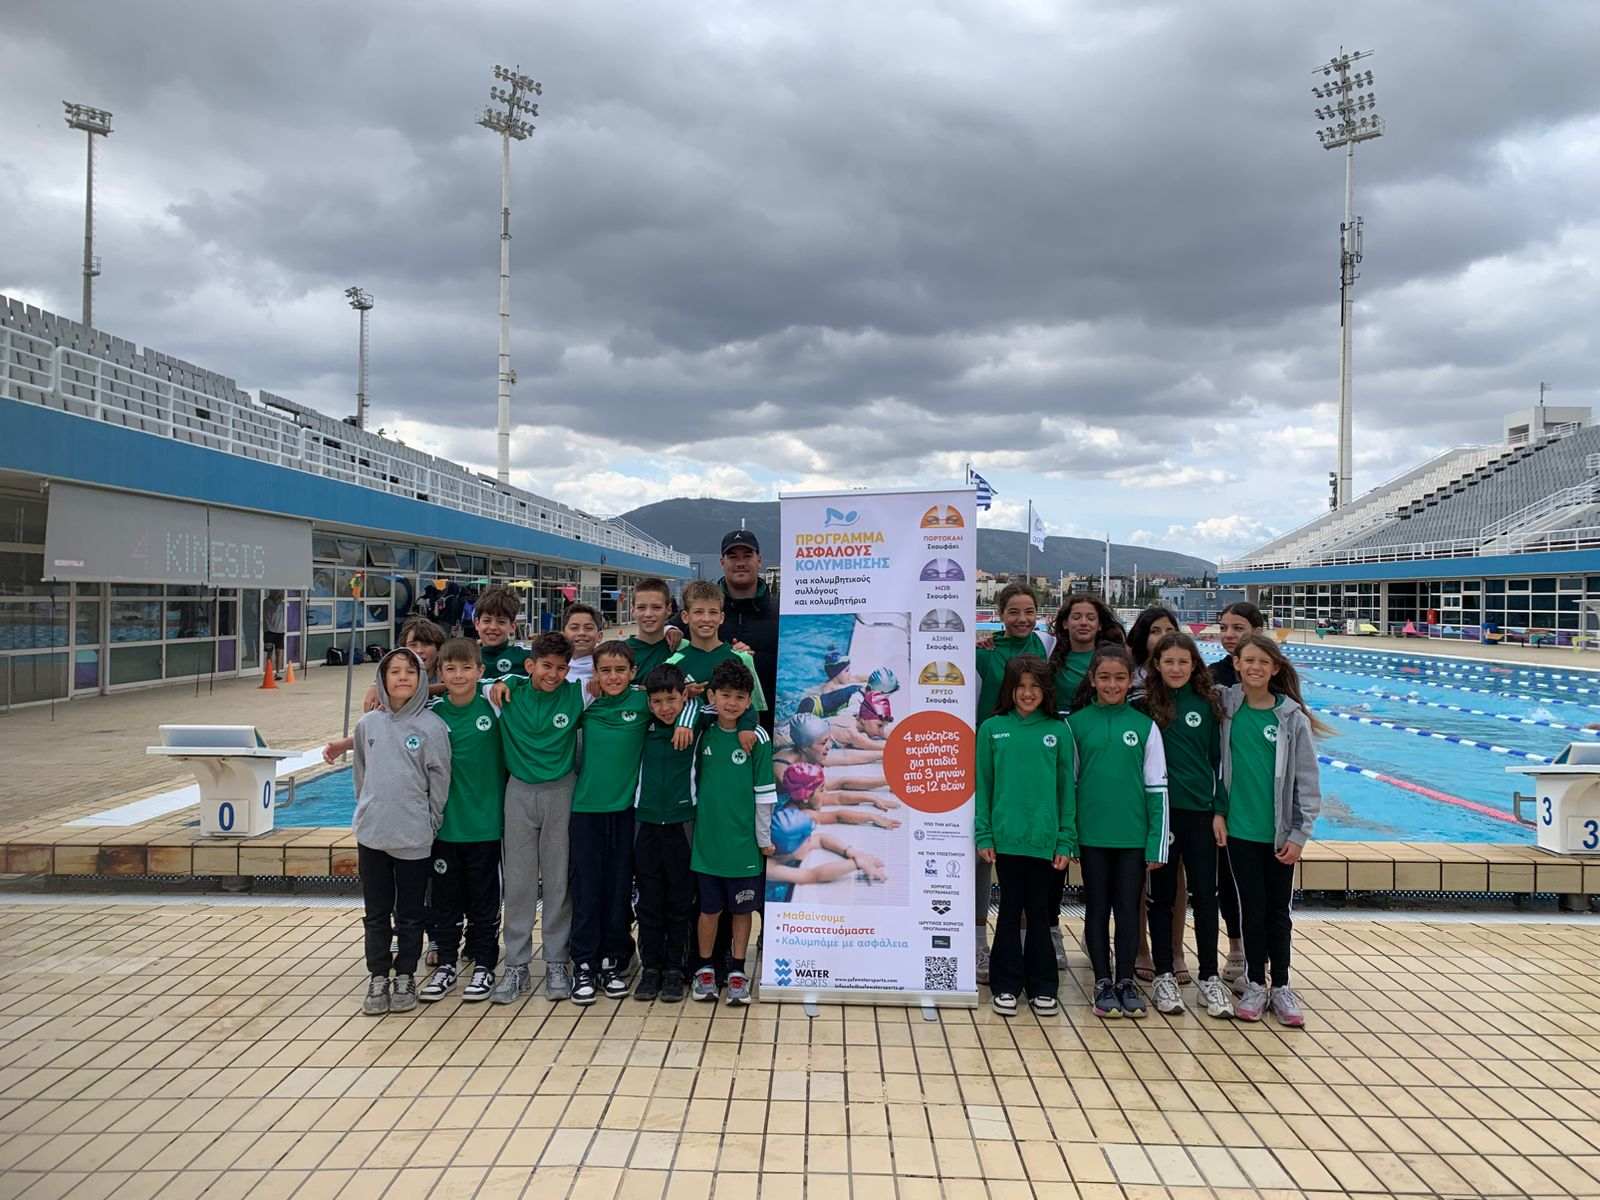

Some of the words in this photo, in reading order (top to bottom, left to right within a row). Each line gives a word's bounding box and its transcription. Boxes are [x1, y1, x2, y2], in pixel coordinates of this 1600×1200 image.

[795, 531, 885, 545] ΠΡΟΓΡΑΜΜΑ
[166, 530, 265, 578] KINESIS
[795, 545, 872, 558] ΑΣΦΑΛΟΥΣ
[795, 557, 890, 571] ΚΟΛΥΜΒΗΣΗΣ
[810, 574, 871, 585] κολυμβητικούς
[794, 587, 839, 595] συλλόγους
[809, 596, 867, 606] κολυμβητήρια
[926, 643, 959, 651] Σκουφάκι
[903, 731, 913, 742] 4
[914, 730, 960, 743] ενότητες
[905, 743, 959, 757] εκμάθησης
[909, 759, 924, 770] για
[926, 755, 957, 766] παιδιά
[903, 769, 923, 781] από
[924, 768, 934, 780] 3
[935, 767, 966, 782] μηνών
[905, 782, 926, 794] έως
[926, 781, 939, 792] 12
[940, 779, 966, 792] ετών
[263, 780, 271, 808] 0
[218, 802, 234, 831] 0
[1542, 796, 1552, 826] 3
[1582, 820, 1599, 849] 3
[783, 911, 845, 923] Μαθαίνουμε
[782, 923, 876, 937] Προστατευόμαστε
[782, 936, 839, 948] Κολυμπάμε
[841, 940, 854, 949] με
[856, 938, 909, 949] ασφάλεια
[795, 960, 816, 969] SAFE
[795, 969, 829, 978] WATER
[795, 979, 828, 987] SPORTS
